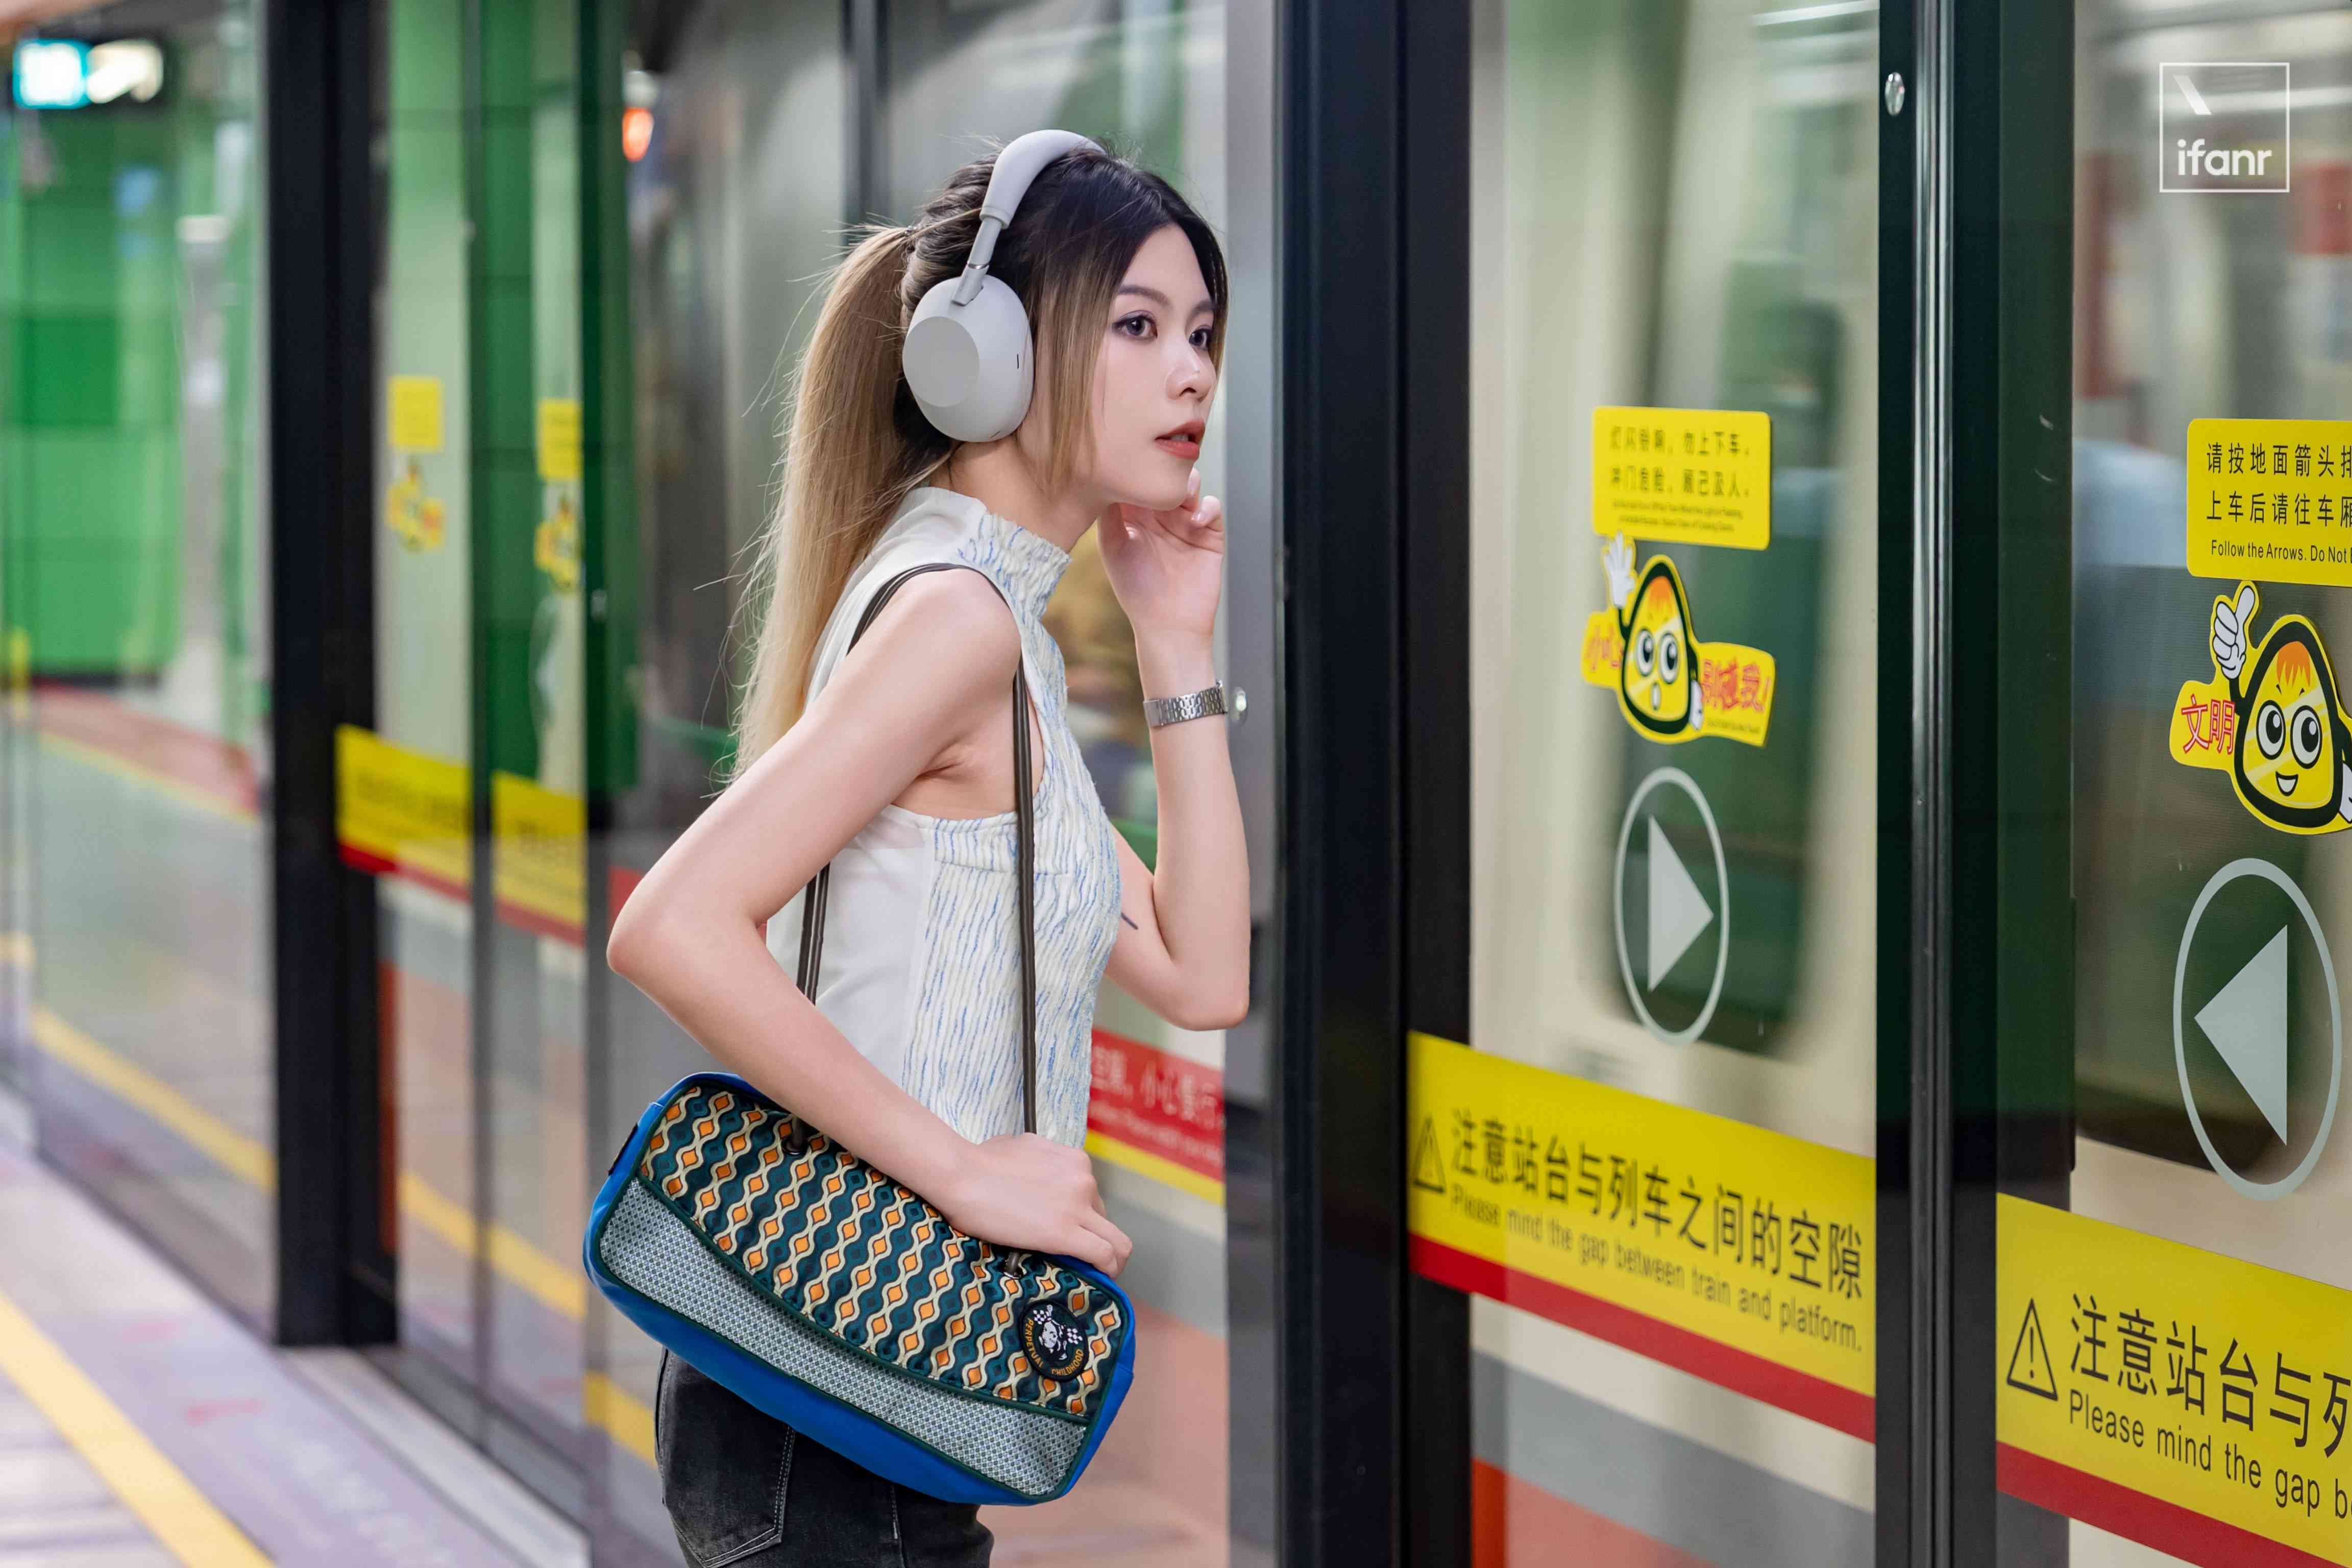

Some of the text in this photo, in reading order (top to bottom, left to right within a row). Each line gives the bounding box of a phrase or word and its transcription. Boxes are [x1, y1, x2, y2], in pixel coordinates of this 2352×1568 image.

[2207, 442, 2352, 478] 请按地面箭头排
[2206, 490, 2352, 528] 上车后请往车厢
[2211, 540, 2244, 557] Follow
[2248, 542, 2263, 558] the
[2266, 543, 2306, 560] Arrows.
[2311, 545, 2324, 562] Do
[2328, 546, 2347, 564] Not
[2181, 693, 2236, 755] 文明
[1451, 1107, 1863, 1300] 注意站台与列车之间的空隙
[1451, 1183, 1863, 1353] Please mind the gap between train and platform.
[1024, 1317, 1045, 1368] PERPETUAL
[1051, 1349, 1084, 1376] CHILDHOOD
[2070, 1388, 2144, 1449] Please
[2157, 1425, 2212, 1473] mind
[2224, 1442, 2262, 1489] the
[2275, 1468, 2320, 1517] gap
